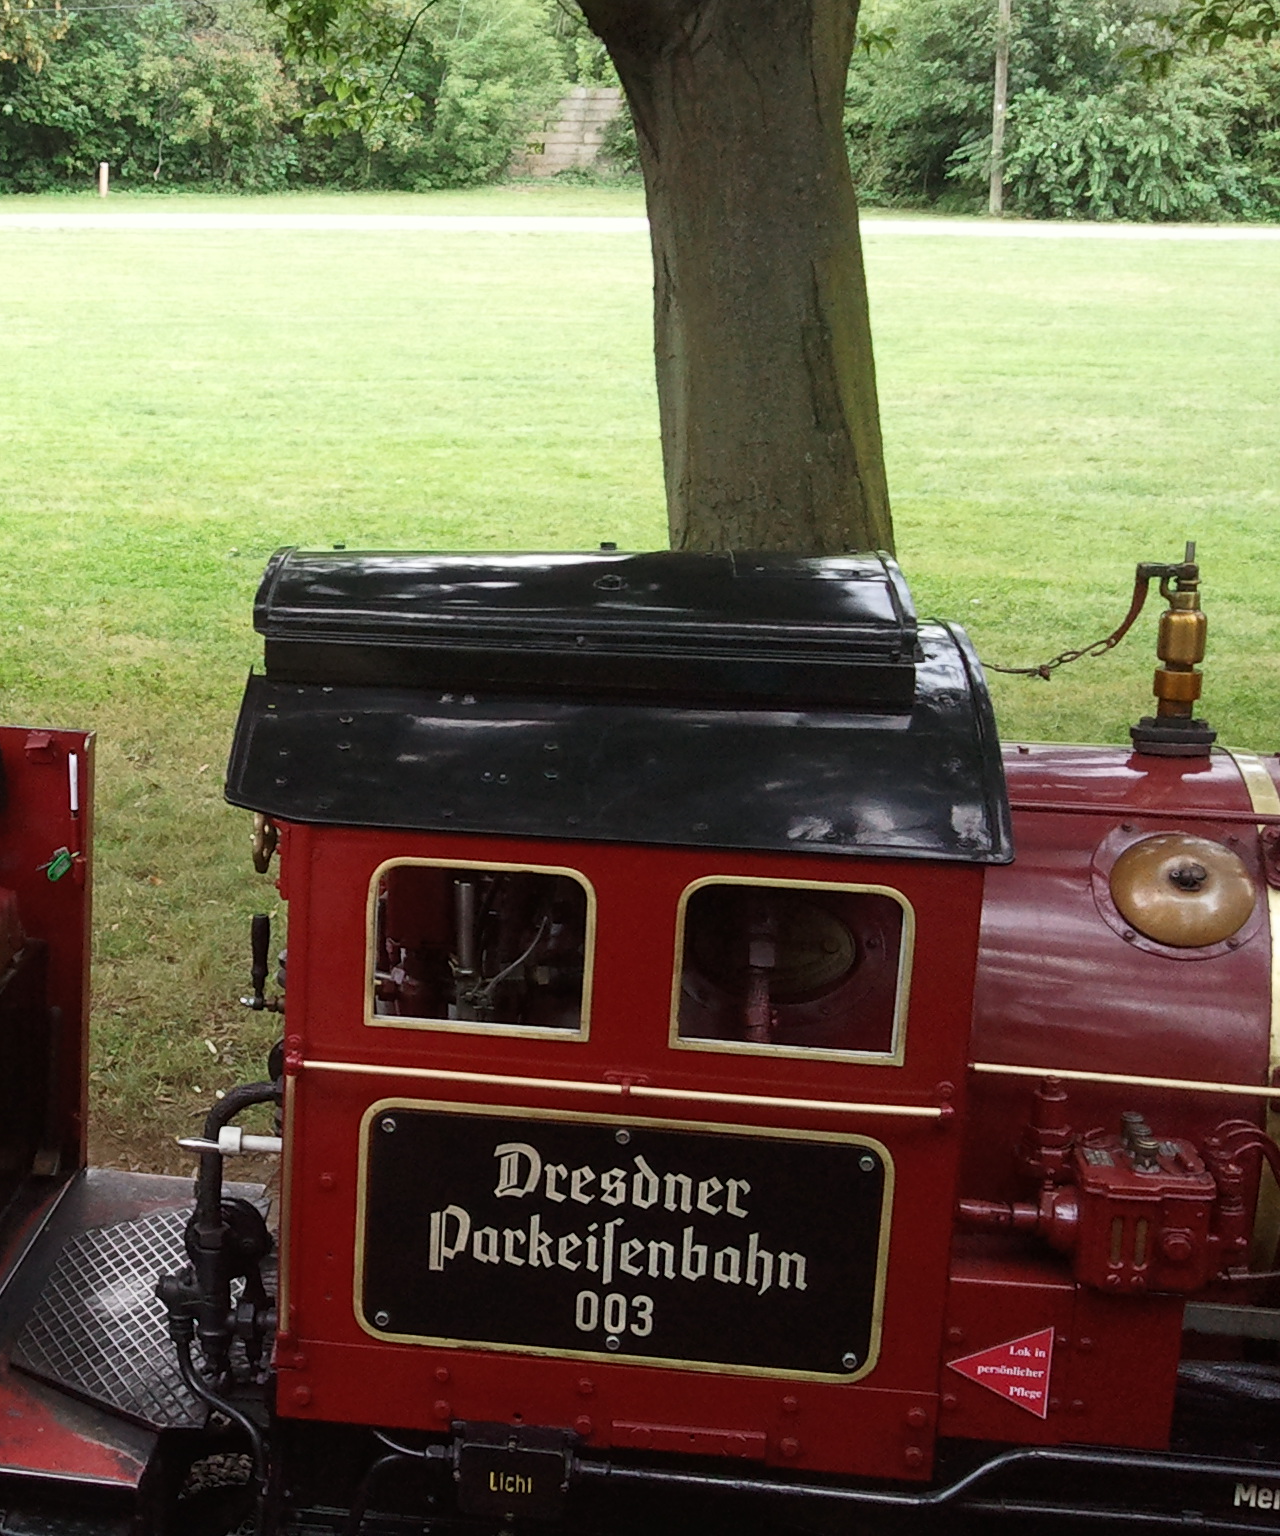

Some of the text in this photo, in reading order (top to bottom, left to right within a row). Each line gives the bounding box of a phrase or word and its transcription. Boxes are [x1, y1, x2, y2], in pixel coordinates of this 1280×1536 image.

[493, 1142, 752, 1219] Dresdner
[576, 1290, 654, 1337] 003
[1009, 1345, 1046, 1358] Lok in
[977, 1365, 1044, 1378] persönlicher
[1008, 1385, 1043, 1399] Pflege
